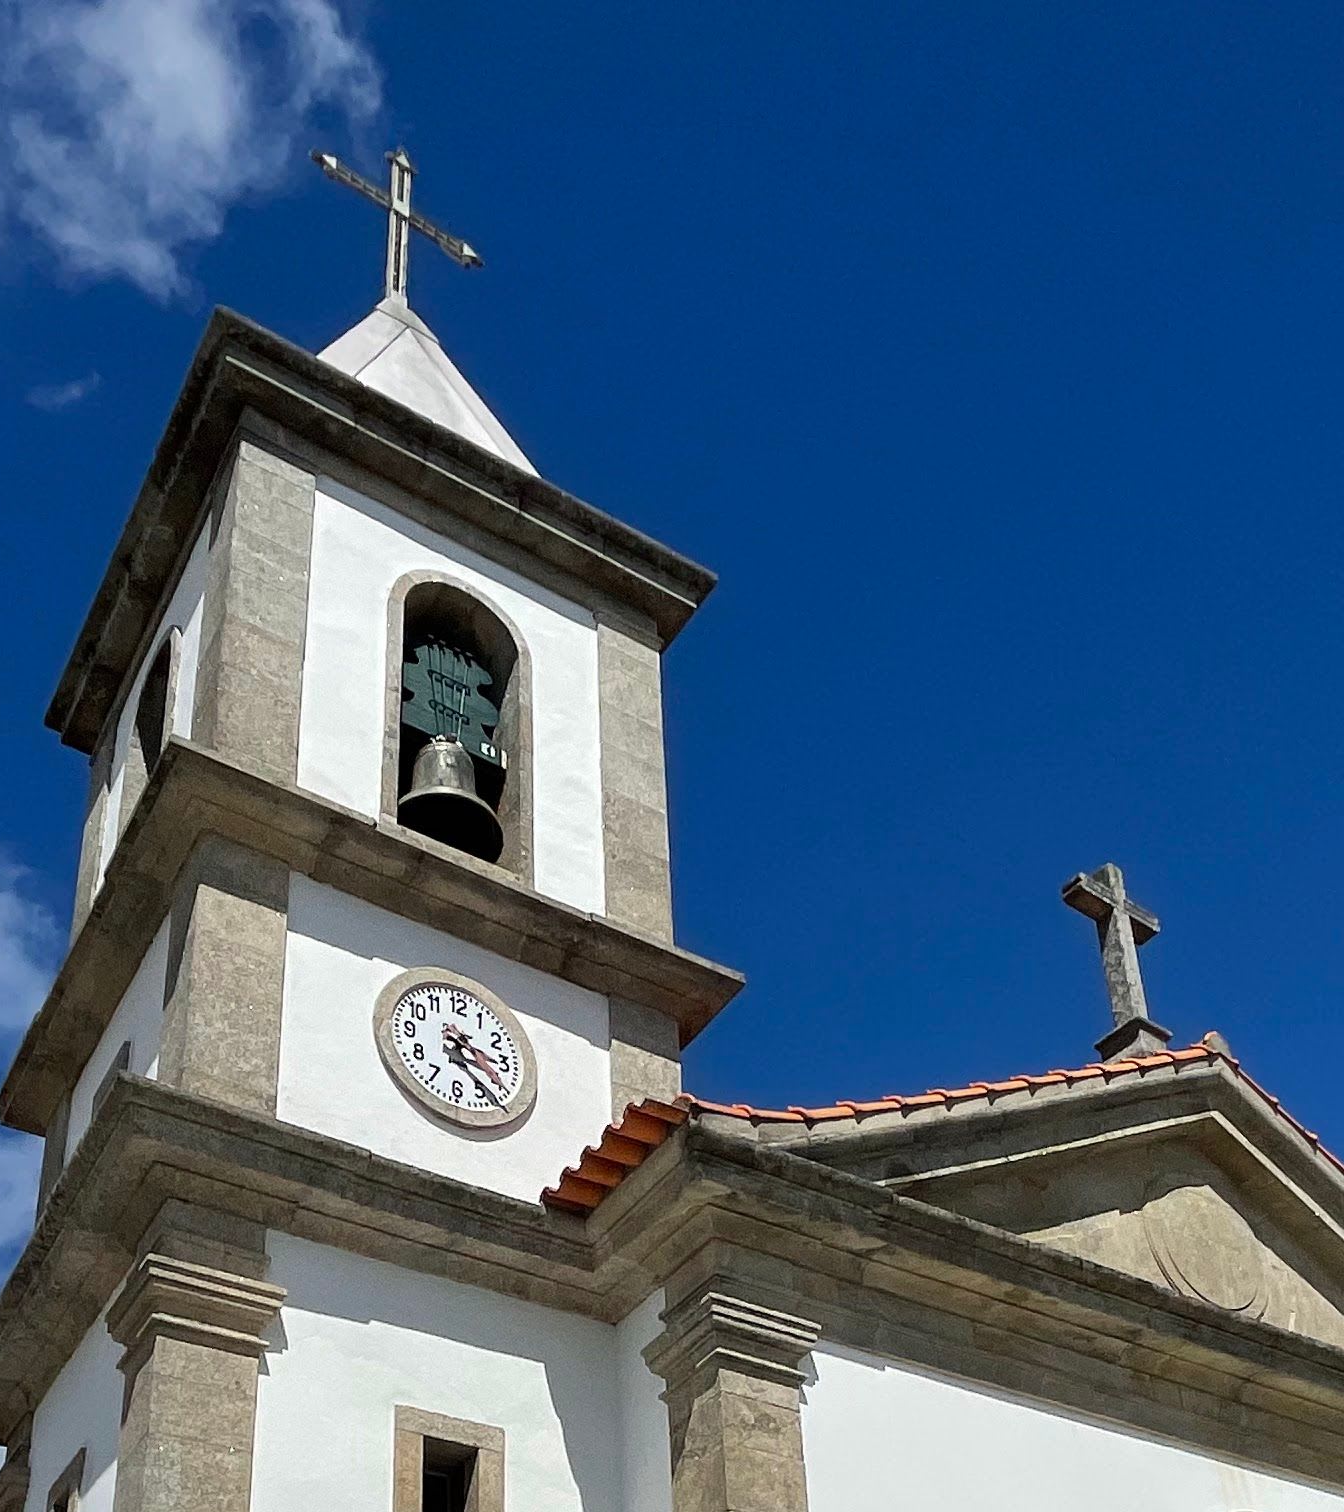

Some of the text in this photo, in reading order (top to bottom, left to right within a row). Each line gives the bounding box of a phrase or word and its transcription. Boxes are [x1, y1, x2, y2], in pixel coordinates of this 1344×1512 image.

[409, 1001, 426, 1021] 10
[450, 996, 468, 1017] 12
[404, 1020, 416, 1038] 9
[476, 1012, 483, 1030] 1
[490, 1032, 502, 1050] 2
[413, 1043, 424, 1060] 8
[429, 1063, 441, 1081] 7
[498, 1054, 510, 1073] 3
[451, 1080, 464, 1098] 6
